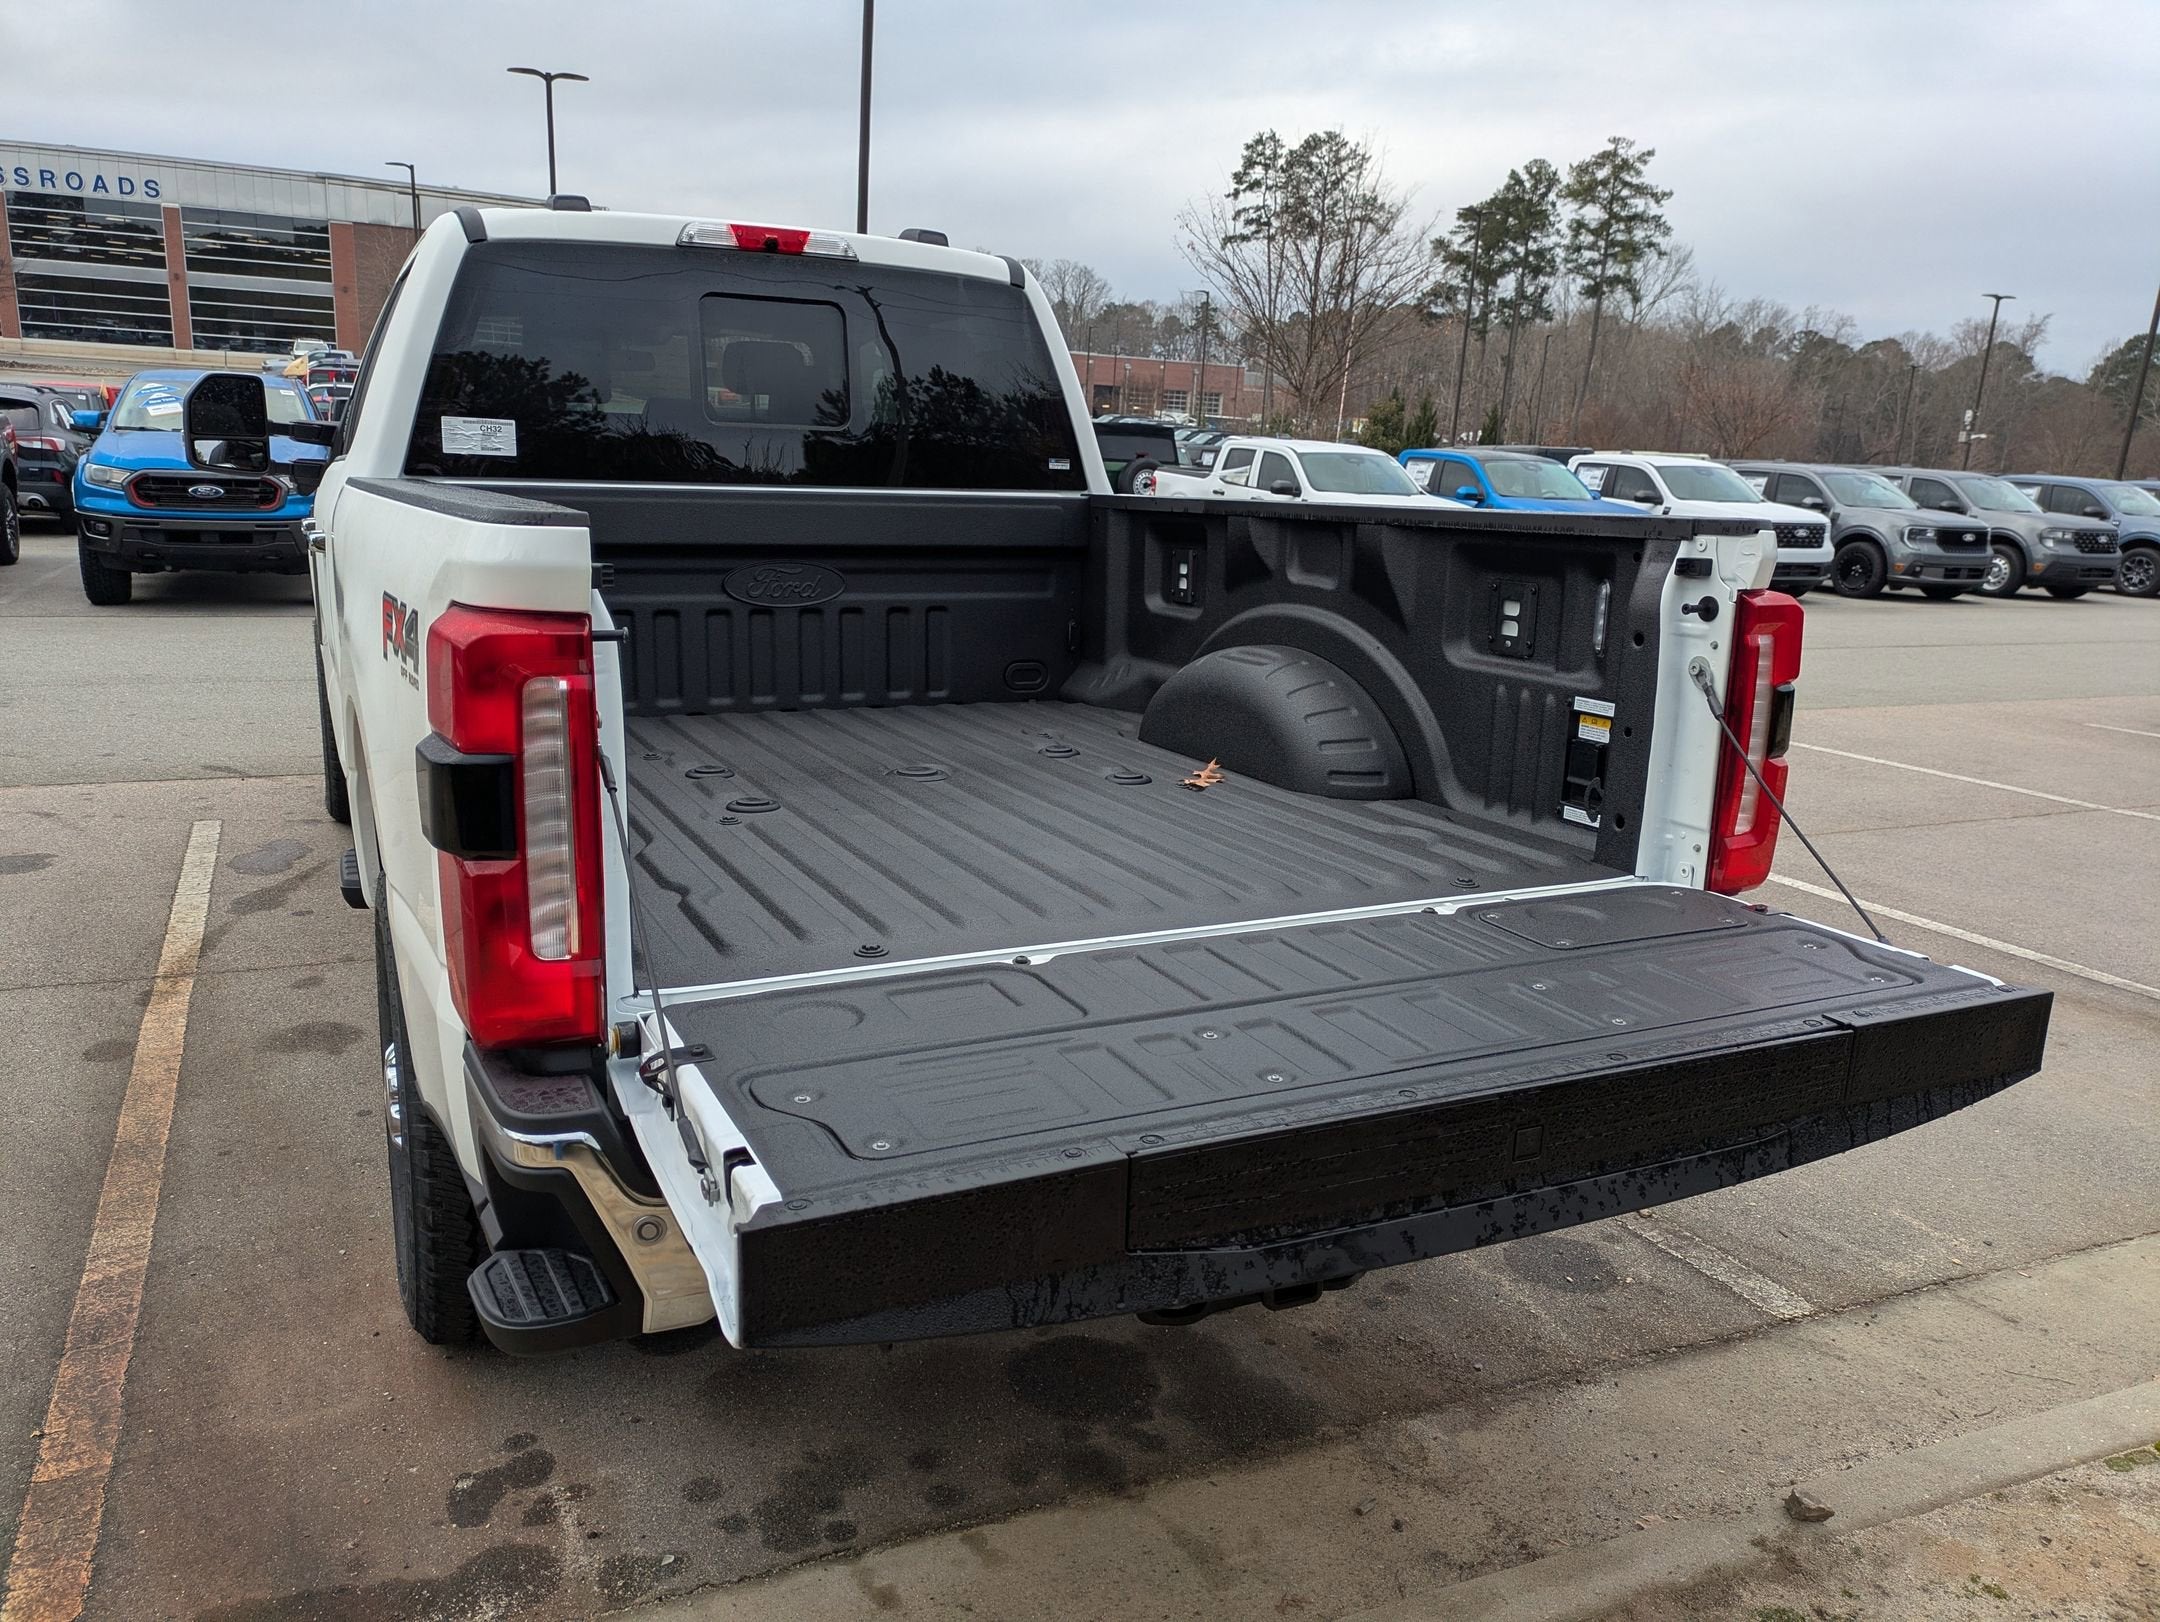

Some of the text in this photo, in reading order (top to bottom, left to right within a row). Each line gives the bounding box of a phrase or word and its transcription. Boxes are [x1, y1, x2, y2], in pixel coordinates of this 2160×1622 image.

[480, 425, 502, 433] CH32
[747, 567, 822, 598] Ford
[382, 590, 419, 676] FX4
